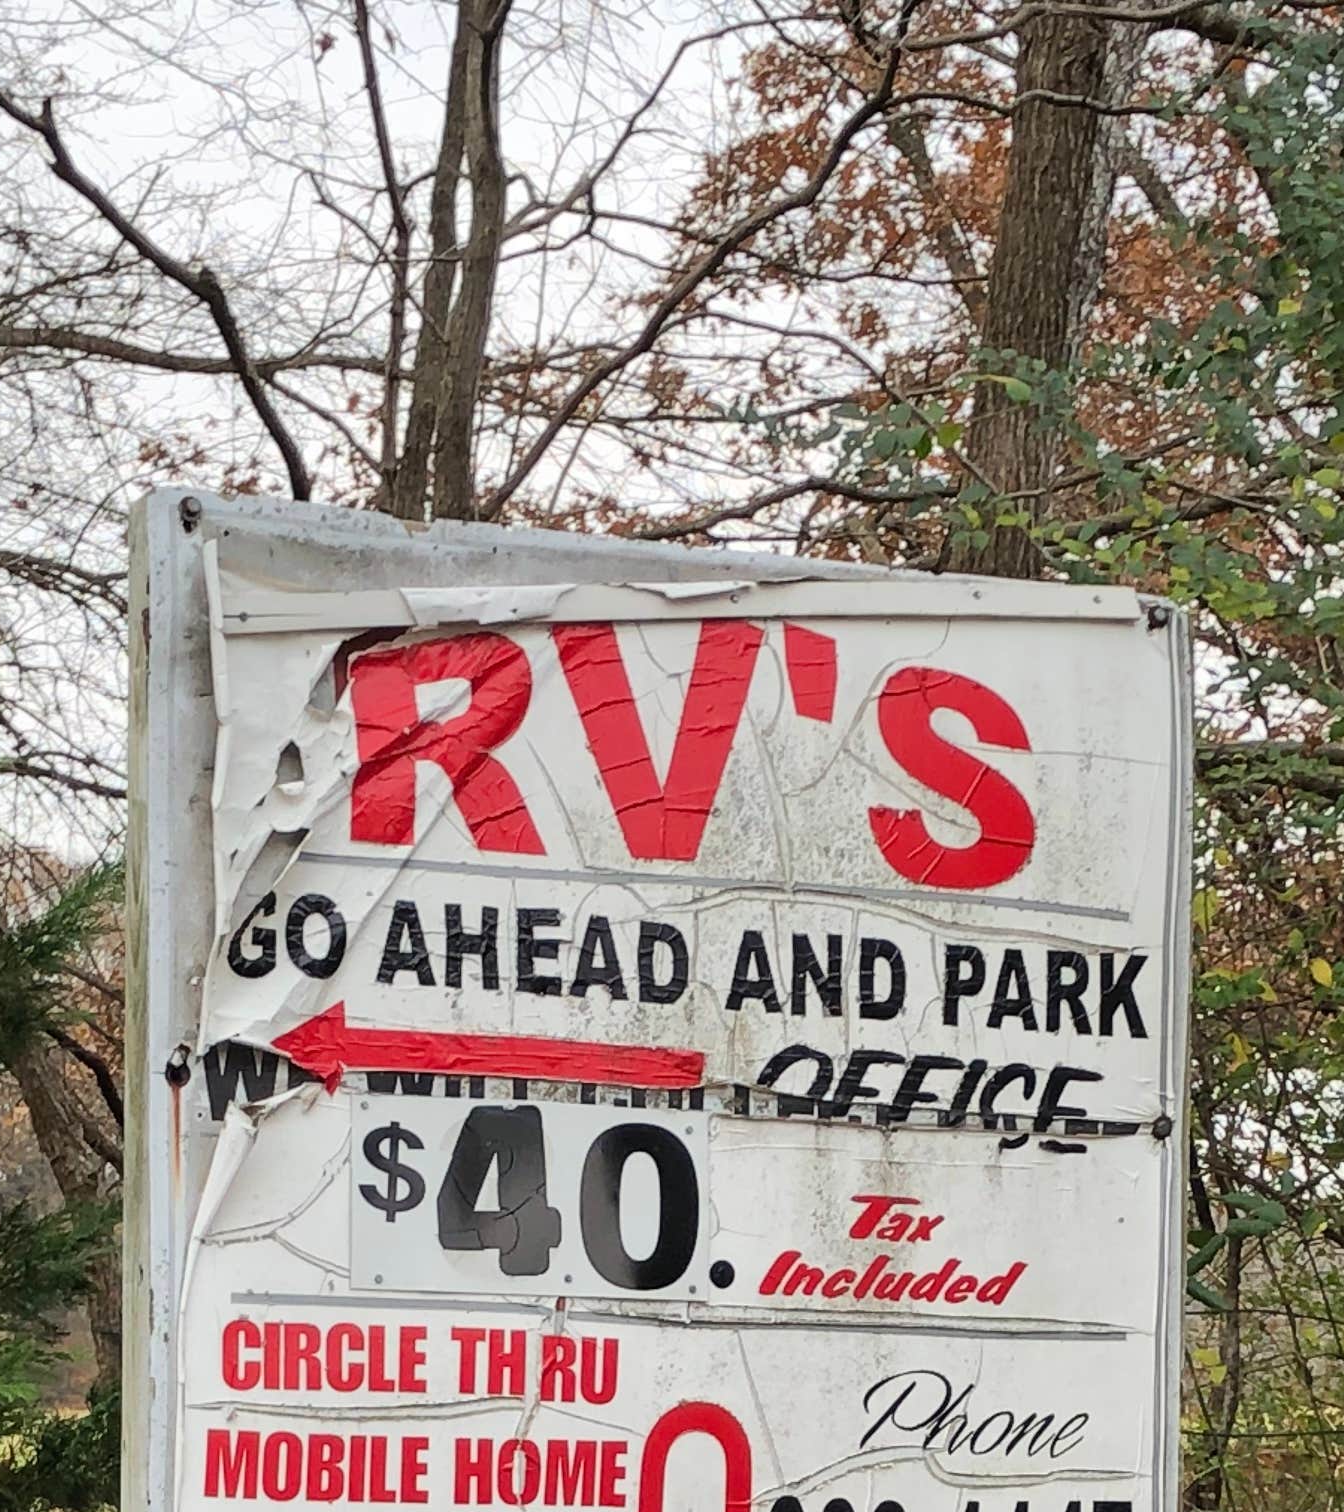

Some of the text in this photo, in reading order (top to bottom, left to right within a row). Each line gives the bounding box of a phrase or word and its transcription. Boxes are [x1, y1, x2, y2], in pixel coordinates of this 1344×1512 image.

[226, 890, 1150, 1039] GO AHEAD AND PARK
[756, 1044, 1105, 1154] OFFICE
[849, 1194, 945, 1243] Tax
[758, 1251, 1028, 1305] Included
[221, 1319, 428, 1393] CIRCLE
[859, 1370, 1090, 1460] Phone
[203, 1428, 628, 1507] MOBILE HOME
